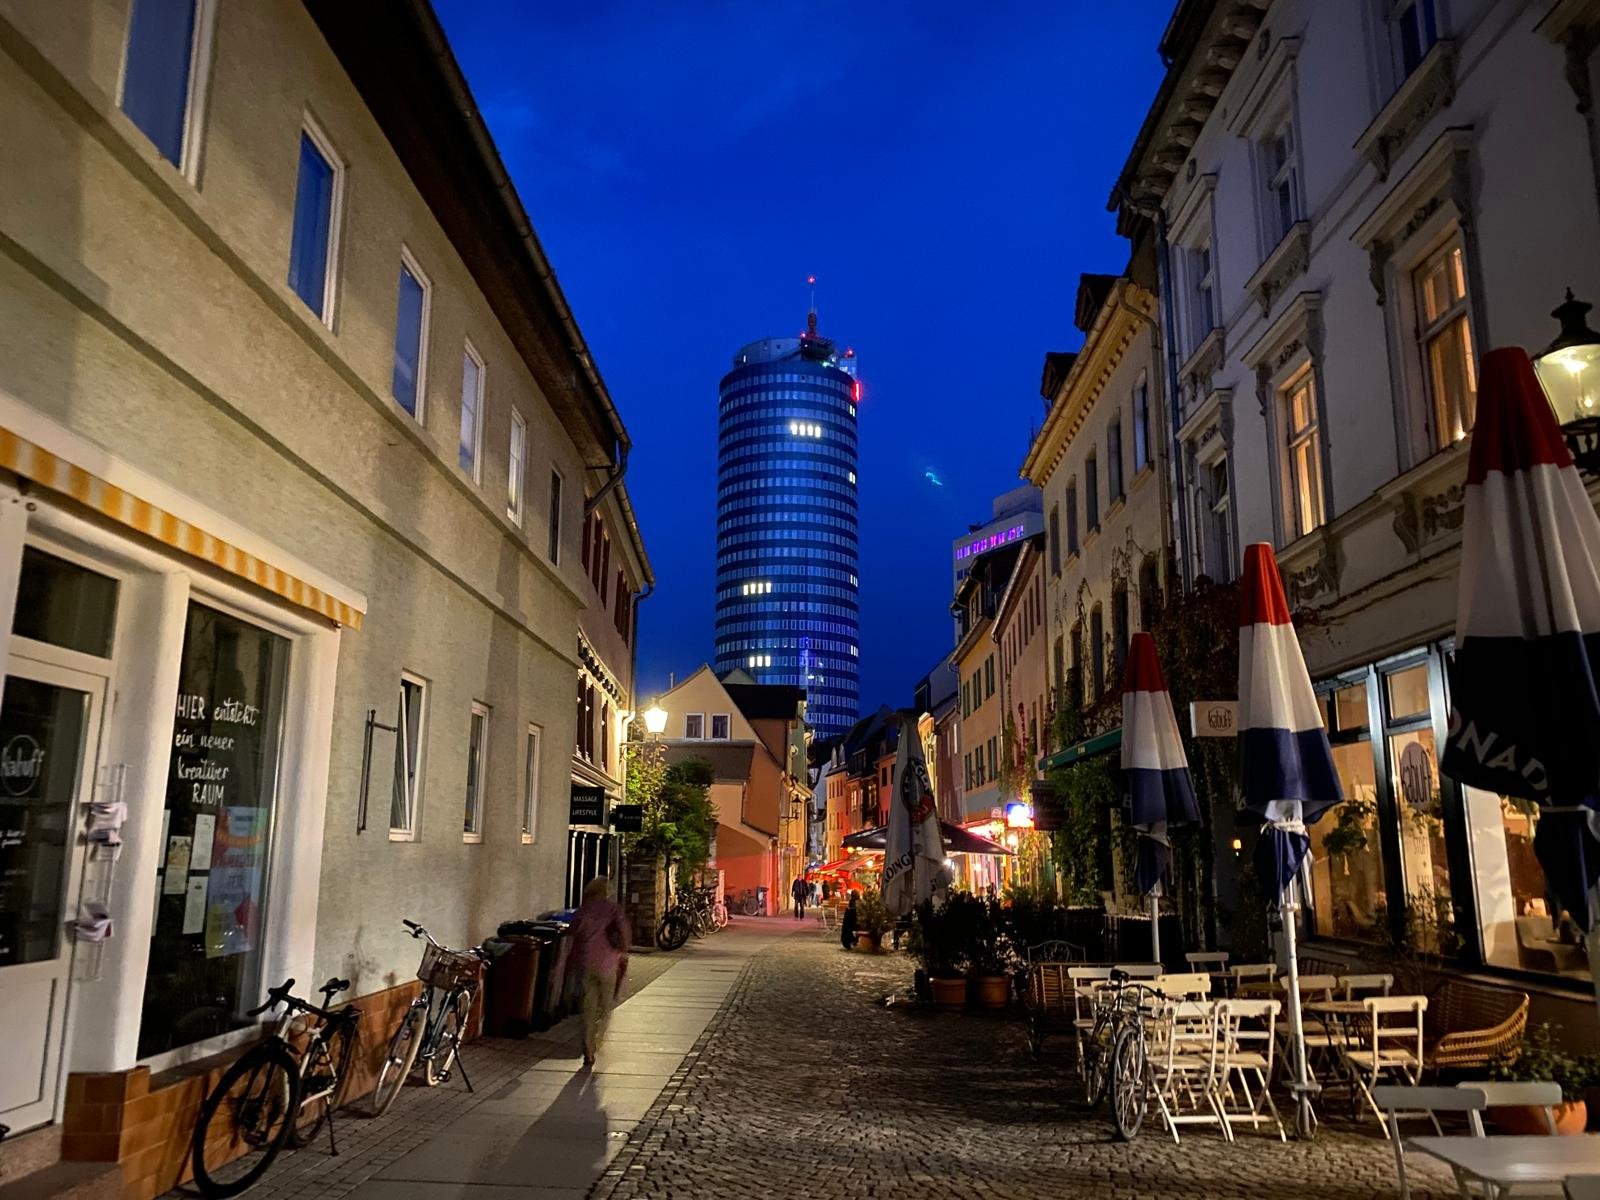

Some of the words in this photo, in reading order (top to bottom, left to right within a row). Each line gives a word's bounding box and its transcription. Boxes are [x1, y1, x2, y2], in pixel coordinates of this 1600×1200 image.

[177, 694, 206, 720] HIER
[175, 729, 195, 748] ein
[200, 735, 235, 750] neuer
[192, 782, 225, 808] RAUM
[573, 795, 598, 803] MASSAGE
[571, 808, 598, 816] LIFESTYLE
